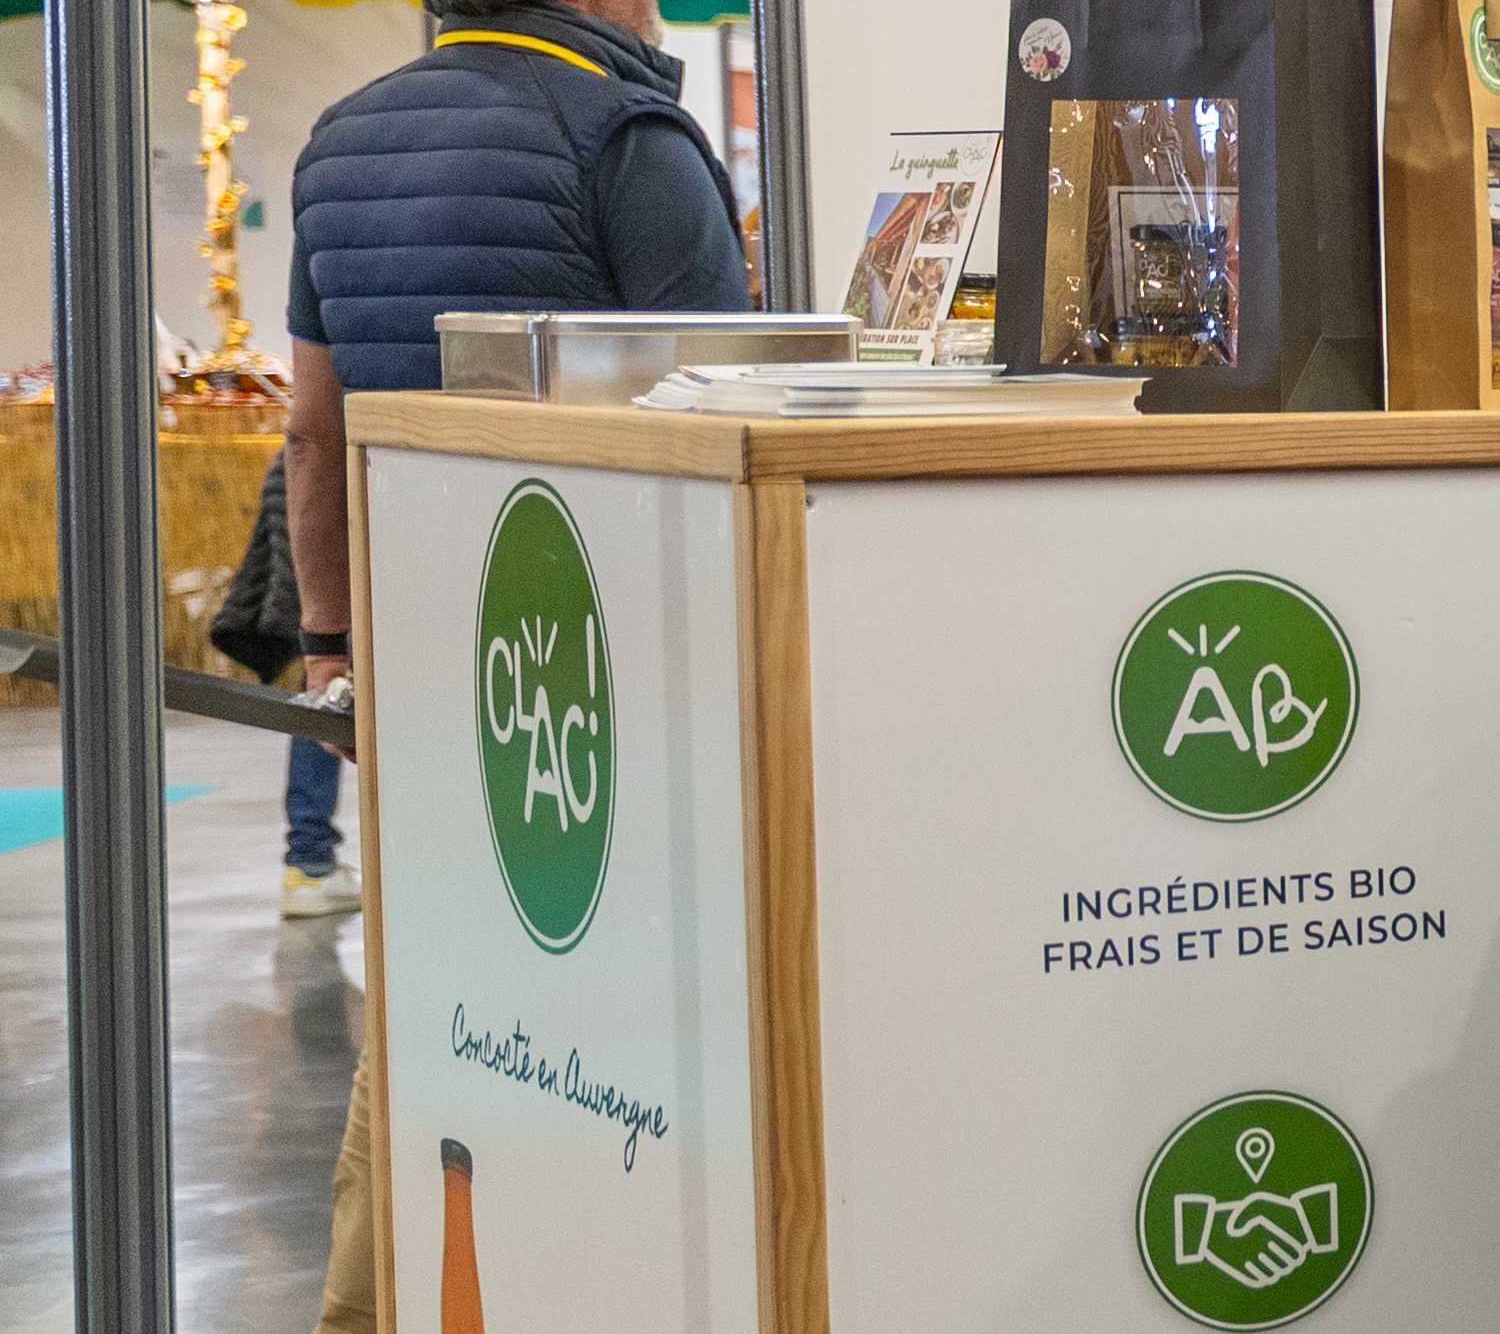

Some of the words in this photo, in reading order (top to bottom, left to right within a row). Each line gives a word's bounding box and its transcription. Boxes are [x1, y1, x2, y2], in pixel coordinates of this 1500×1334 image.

[890, 149, 904, 171] La
[907, 147, 959, 180] guinguette
[486, 614, 598, 833] CLAC!
[1162, 664, 1328, 769] AB
[1061, 871, 1335, 923] INGRÉDIENTS
[1349, 865, 1417, 899] BIO
[1043, 934, 1161, 974] FRAIS
[1176, 928, 1223, 963] ET
[1237, 922, 1290, 957] DE
[1303, 910, 1447, 951] SAISON
[452, 1003, 536, 1083] Concocté
[537, 1060, 561, 1099] en
[563, 1047, 669, 1173] Auvergne
